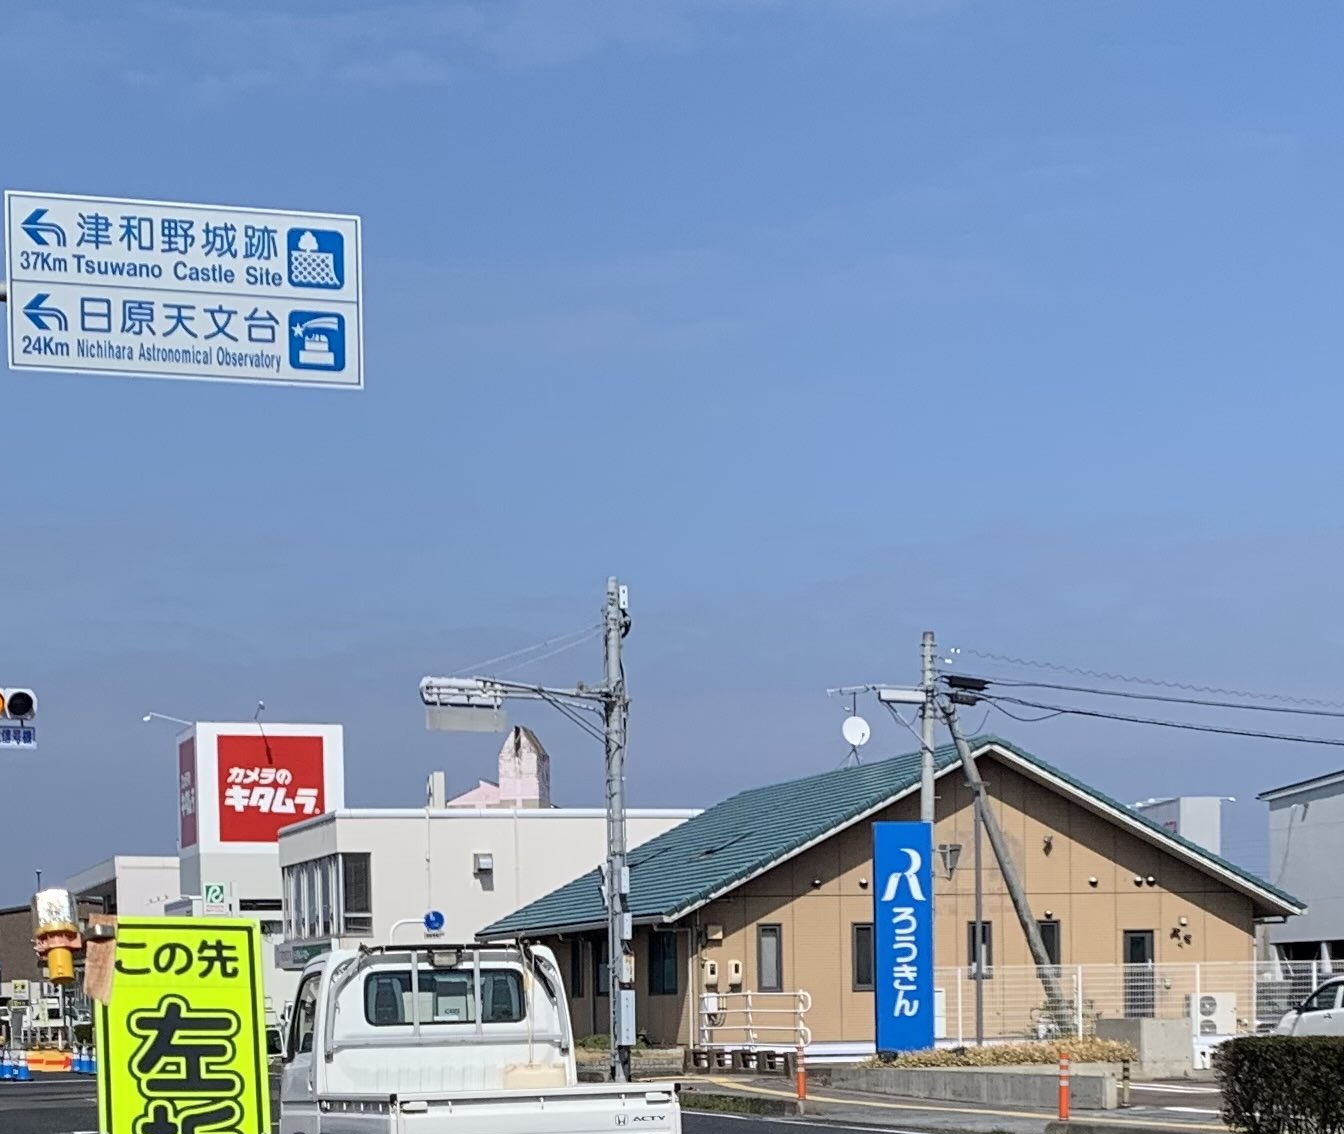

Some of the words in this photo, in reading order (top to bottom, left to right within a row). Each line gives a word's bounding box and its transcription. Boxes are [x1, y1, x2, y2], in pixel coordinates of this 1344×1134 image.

[75, 212, 278, 261] 津和野城跡
[20, 250, 67, 273] 37Km
[72, 254, 163, 279] Tsuwano
[173, 261, 235, 284] Castle
[246, 266, 283, 288] Site
[79, 297, 280, 344] 日原天文台
[22, 335, 70, 357] 24Km
[77, 338, 134, 361] Nichihara
[139, 342, 213, 365] Astronomical
[216, 347, 281, 372] Observatory
[227, 767, 292, 785] カメラの
[116, 939, 239, 978] この先
[891, 907, 919, 1017] ろうきん
